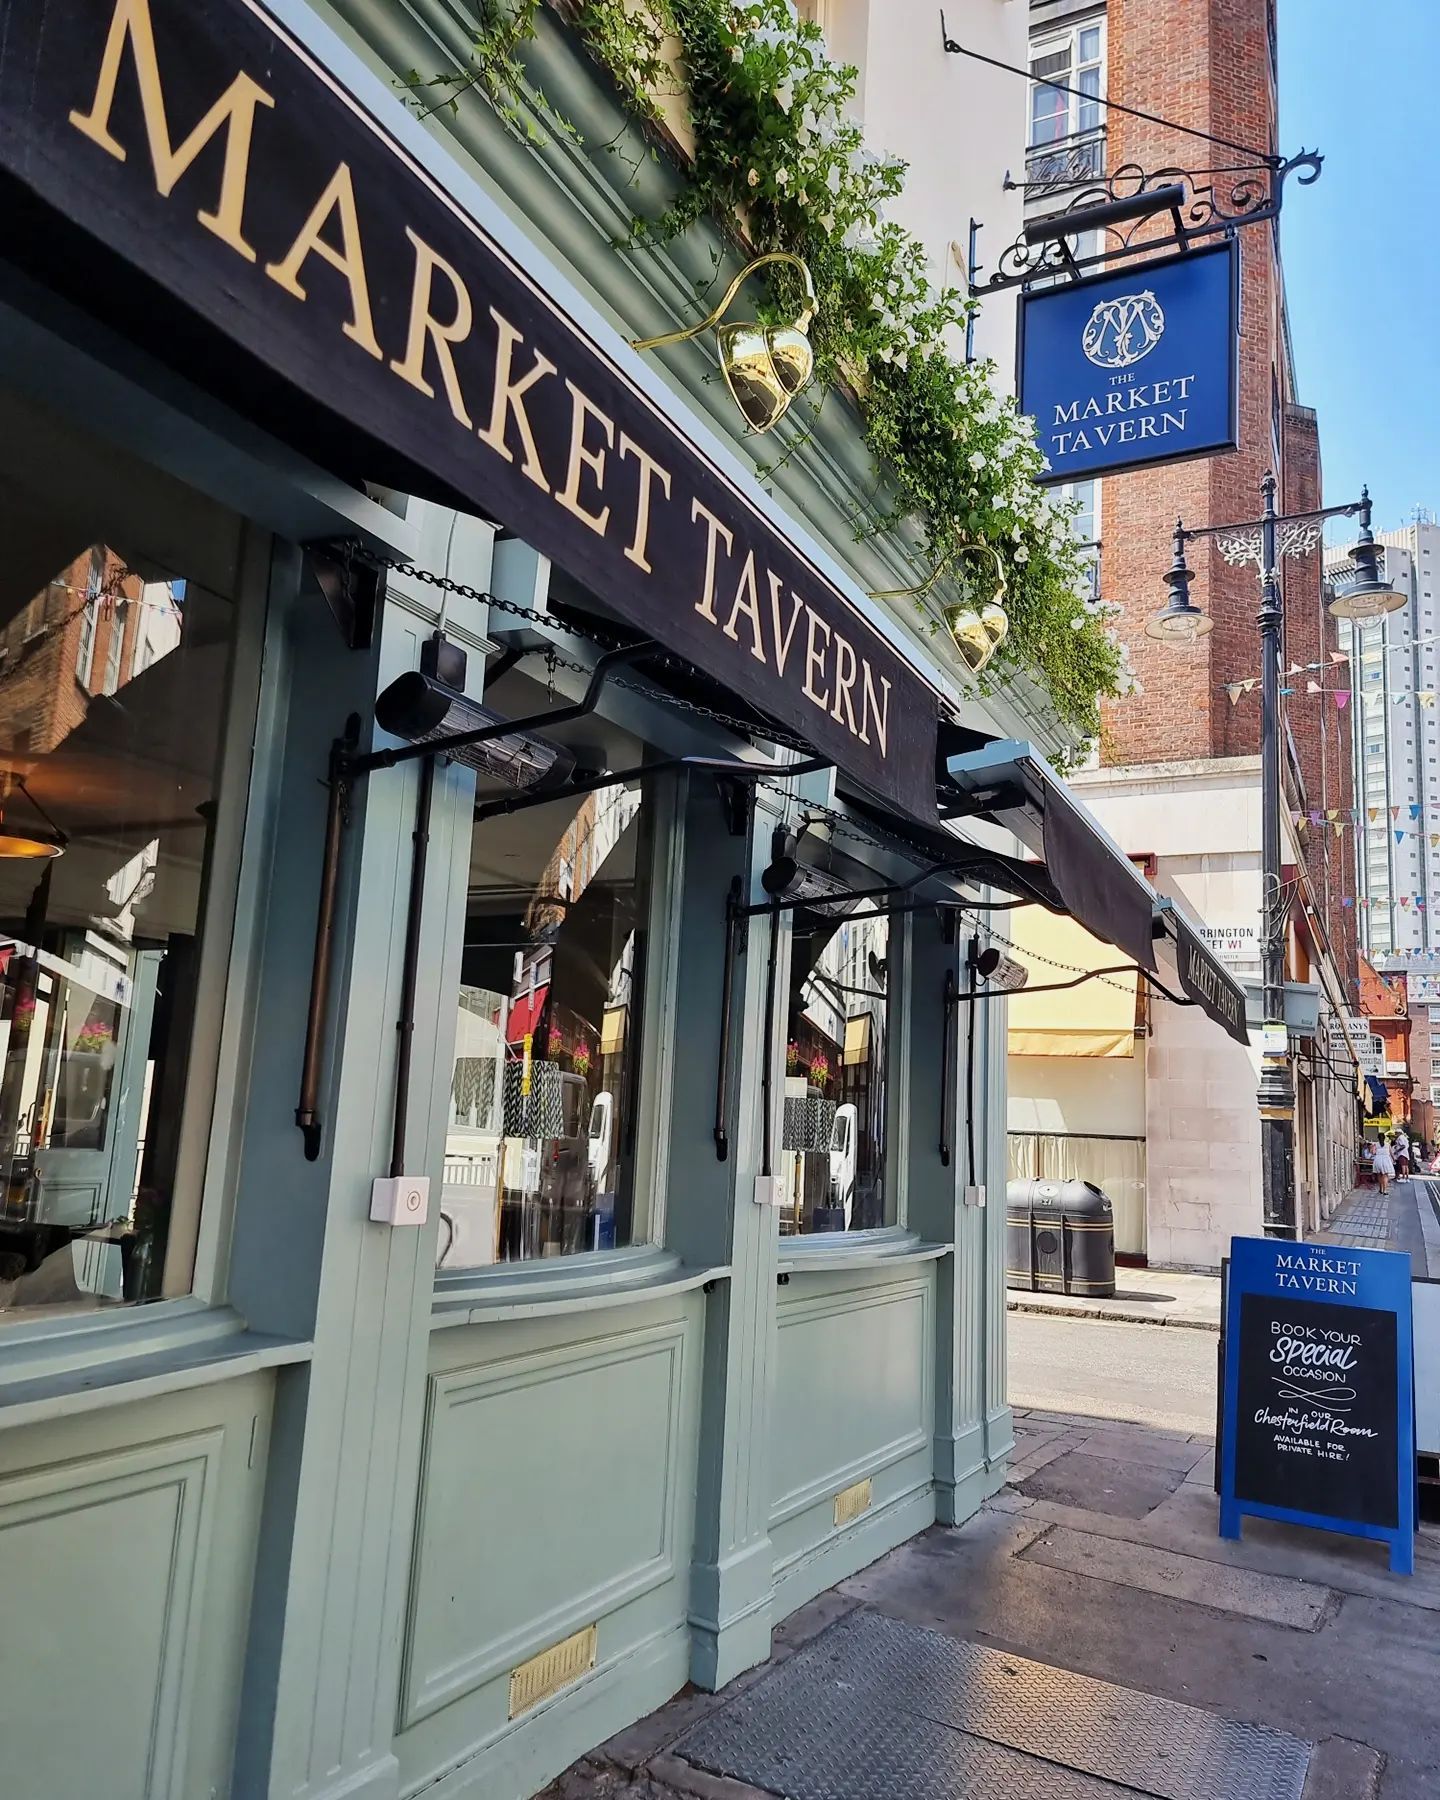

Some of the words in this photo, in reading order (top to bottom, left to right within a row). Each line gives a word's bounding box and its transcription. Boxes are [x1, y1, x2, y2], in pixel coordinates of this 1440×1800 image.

[68, 0, 671, 574] MARKET
[691, 496, 891, 759] TAVERN
[1109, 372, 1136, 386] THE
[1052, 374, 1195, 426] MARKET
[1051, 408, 1189, 455] TAVERN
[1228, 940, 1241, 949] W1
[1187, 944, 1217, 1004] MARKET
[1217, 977, 1240, 1029] TAVERN
[1310, 1247, 1326, 1255] THE
[1276, 1254, 1361, 1276] MARKET
[1275, 1273, 1356, 1295] TAVERN
[1271, 1321, 1317, 1340] BOOK
[1319, 1328, 1362, 1346] YOUR
[1283, 1365, 1346, 1383] OCCASION
[1254, 1407, 1330, 1434] Chesterfield
[1330, 1419, 1378, 1437] Room
[1311, 1410, 1333, 1420] OUR
[1273, 1434, 1321, 1448] AVAILABLE
[1327, 1442, 1346, 1452] FOR
[1277, 1443, 1313, 1455] PRIVATE
